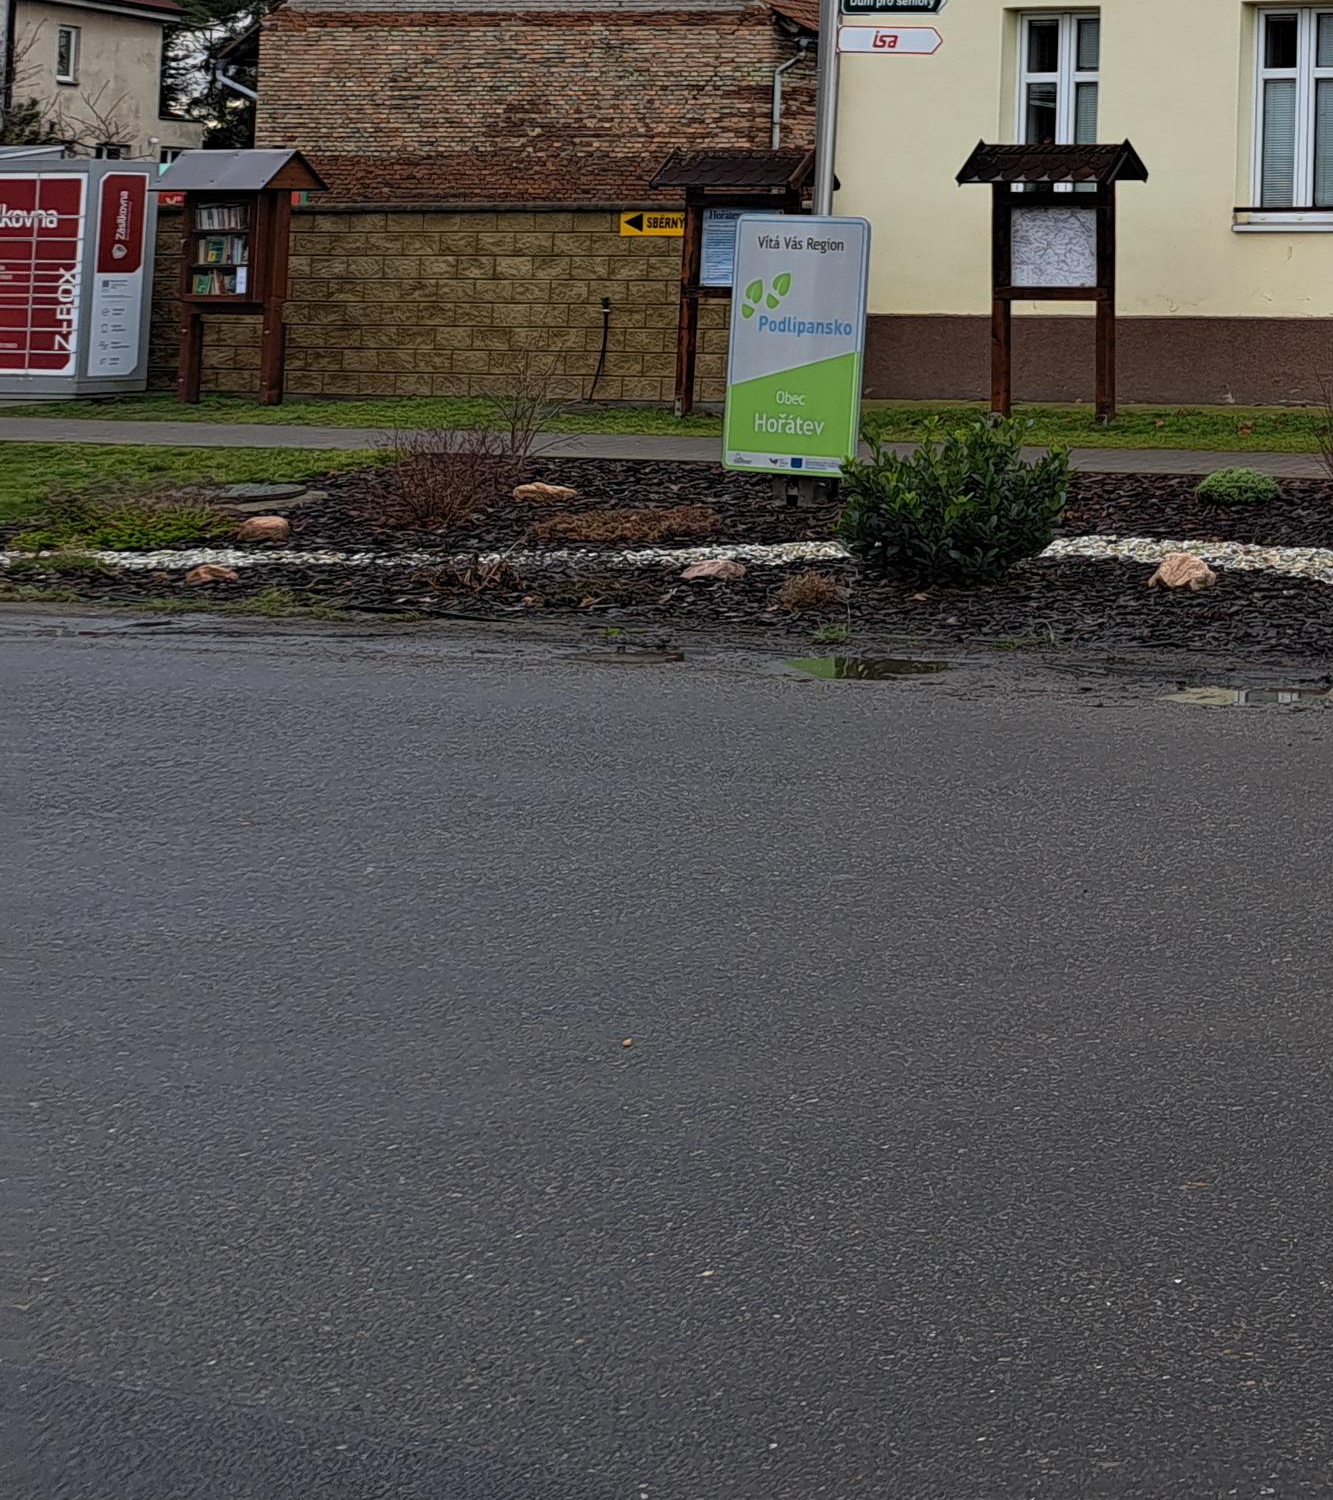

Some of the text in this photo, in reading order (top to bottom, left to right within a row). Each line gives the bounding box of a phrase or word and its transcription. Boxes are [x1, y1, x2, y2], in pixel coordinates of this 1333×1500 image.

[0, 203, 58, 228] kovna
[758, 235, 845, 254] Vítá Vás Region
[54, 267, 77, 351] Z-BOX
[758, 315, 853, 338] Podlipansko
[776, 390, 806, 406] Obec
[754, 412, 825, 436] Hořátev
